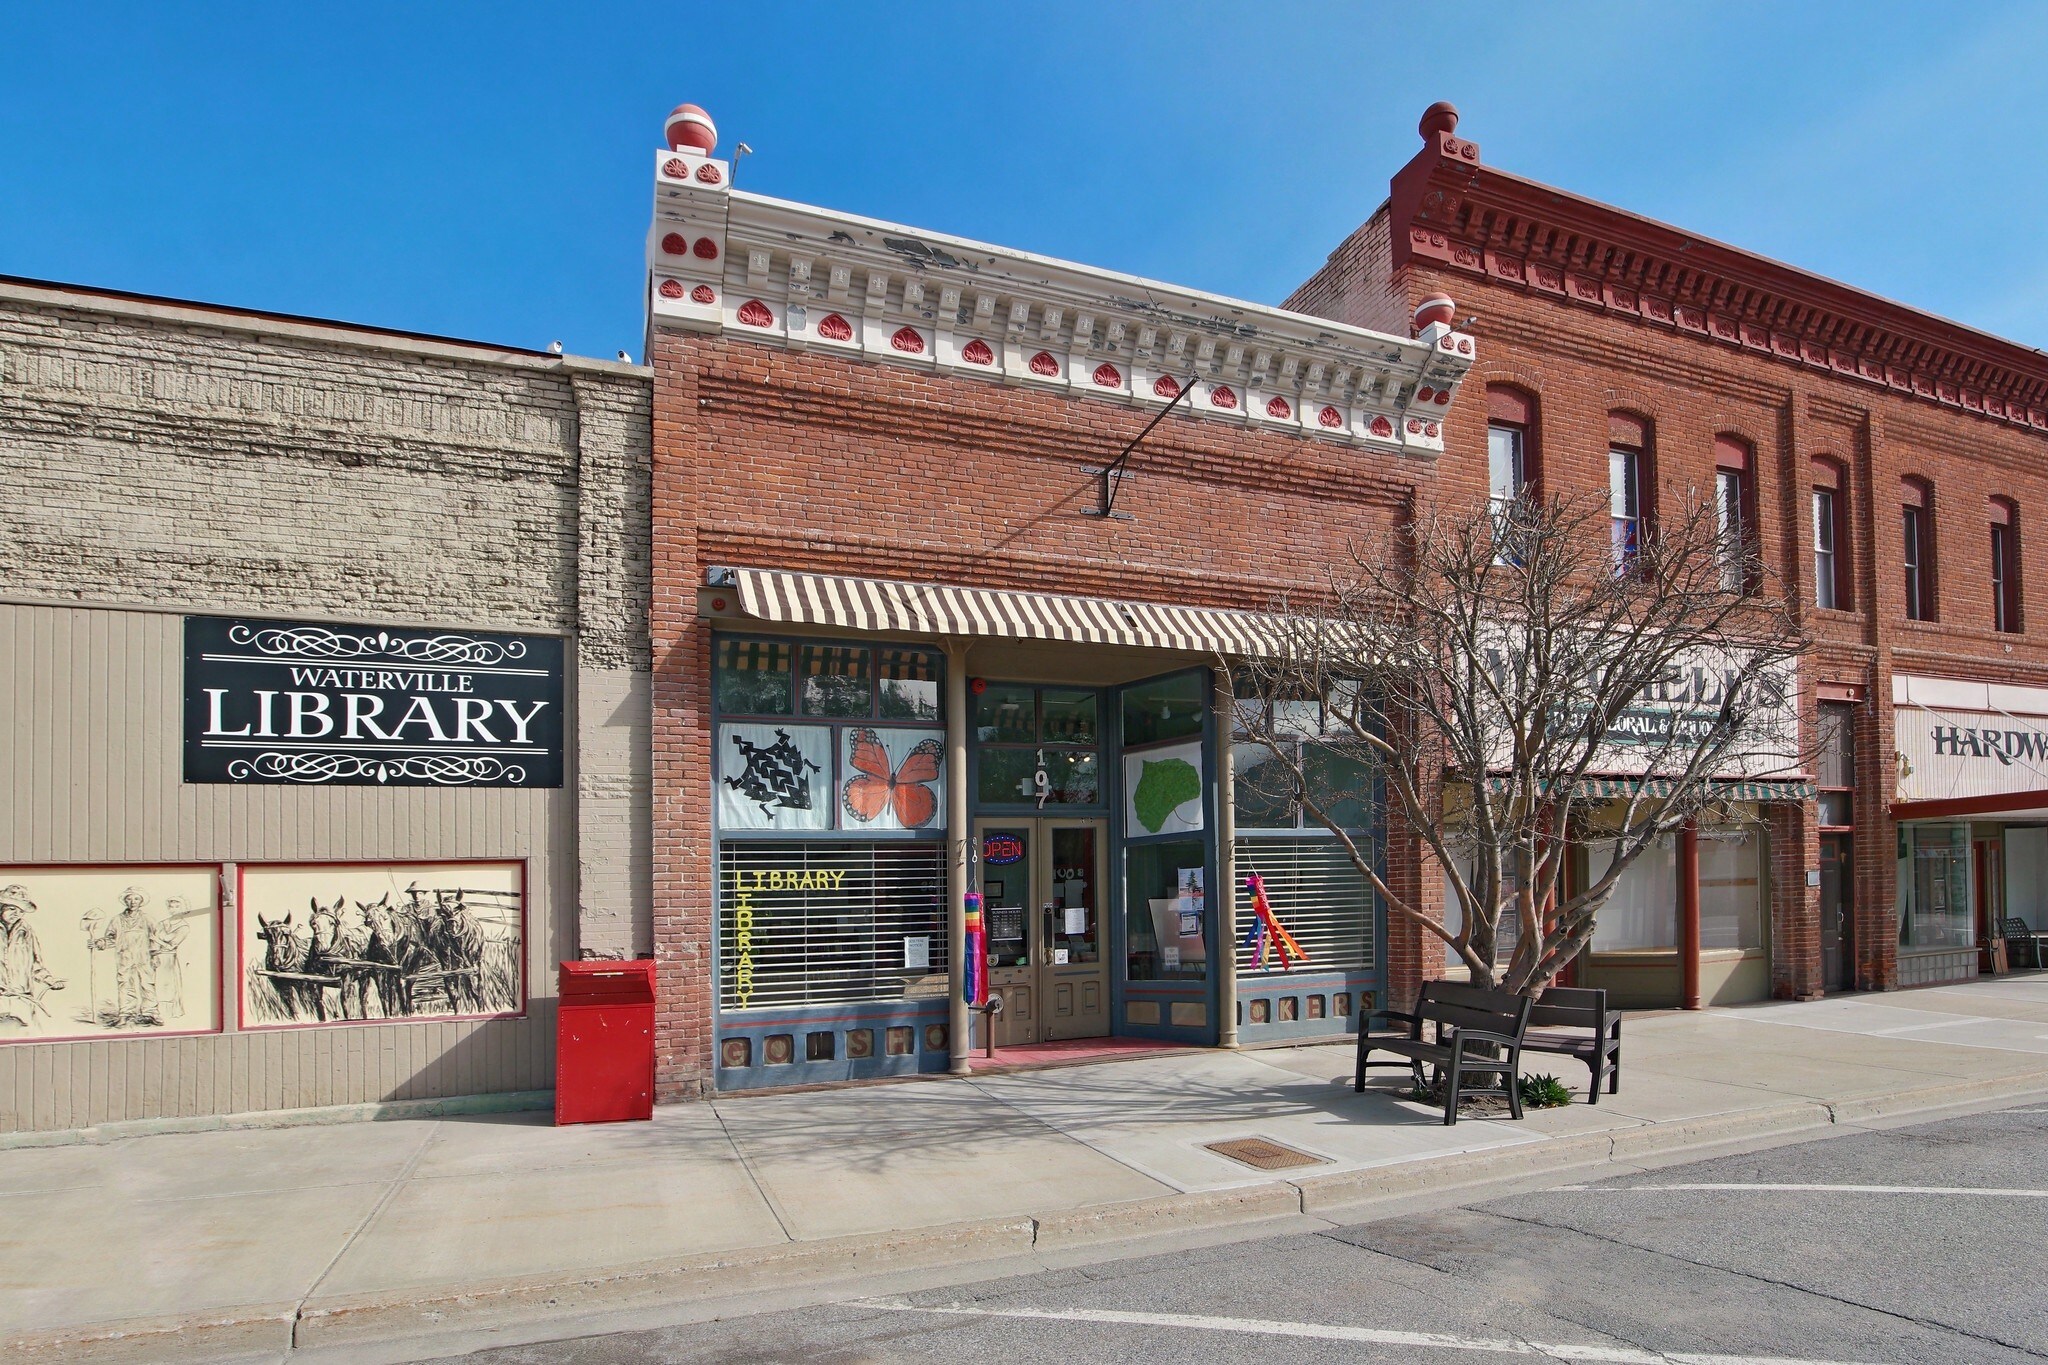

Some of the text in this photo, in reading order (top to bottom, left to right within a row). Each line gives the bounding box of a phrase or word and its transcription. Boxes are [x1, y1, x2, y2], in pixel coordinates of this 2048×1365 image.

[289, 667, 474, 692] WATERVILLE
[202, 688, 549, 743] LIBRARY
[1930, 725, 2048, 766] HARDW
[1035, 748, 1048, 809] 107
[736, 869, 845, 891] LIBRARY
